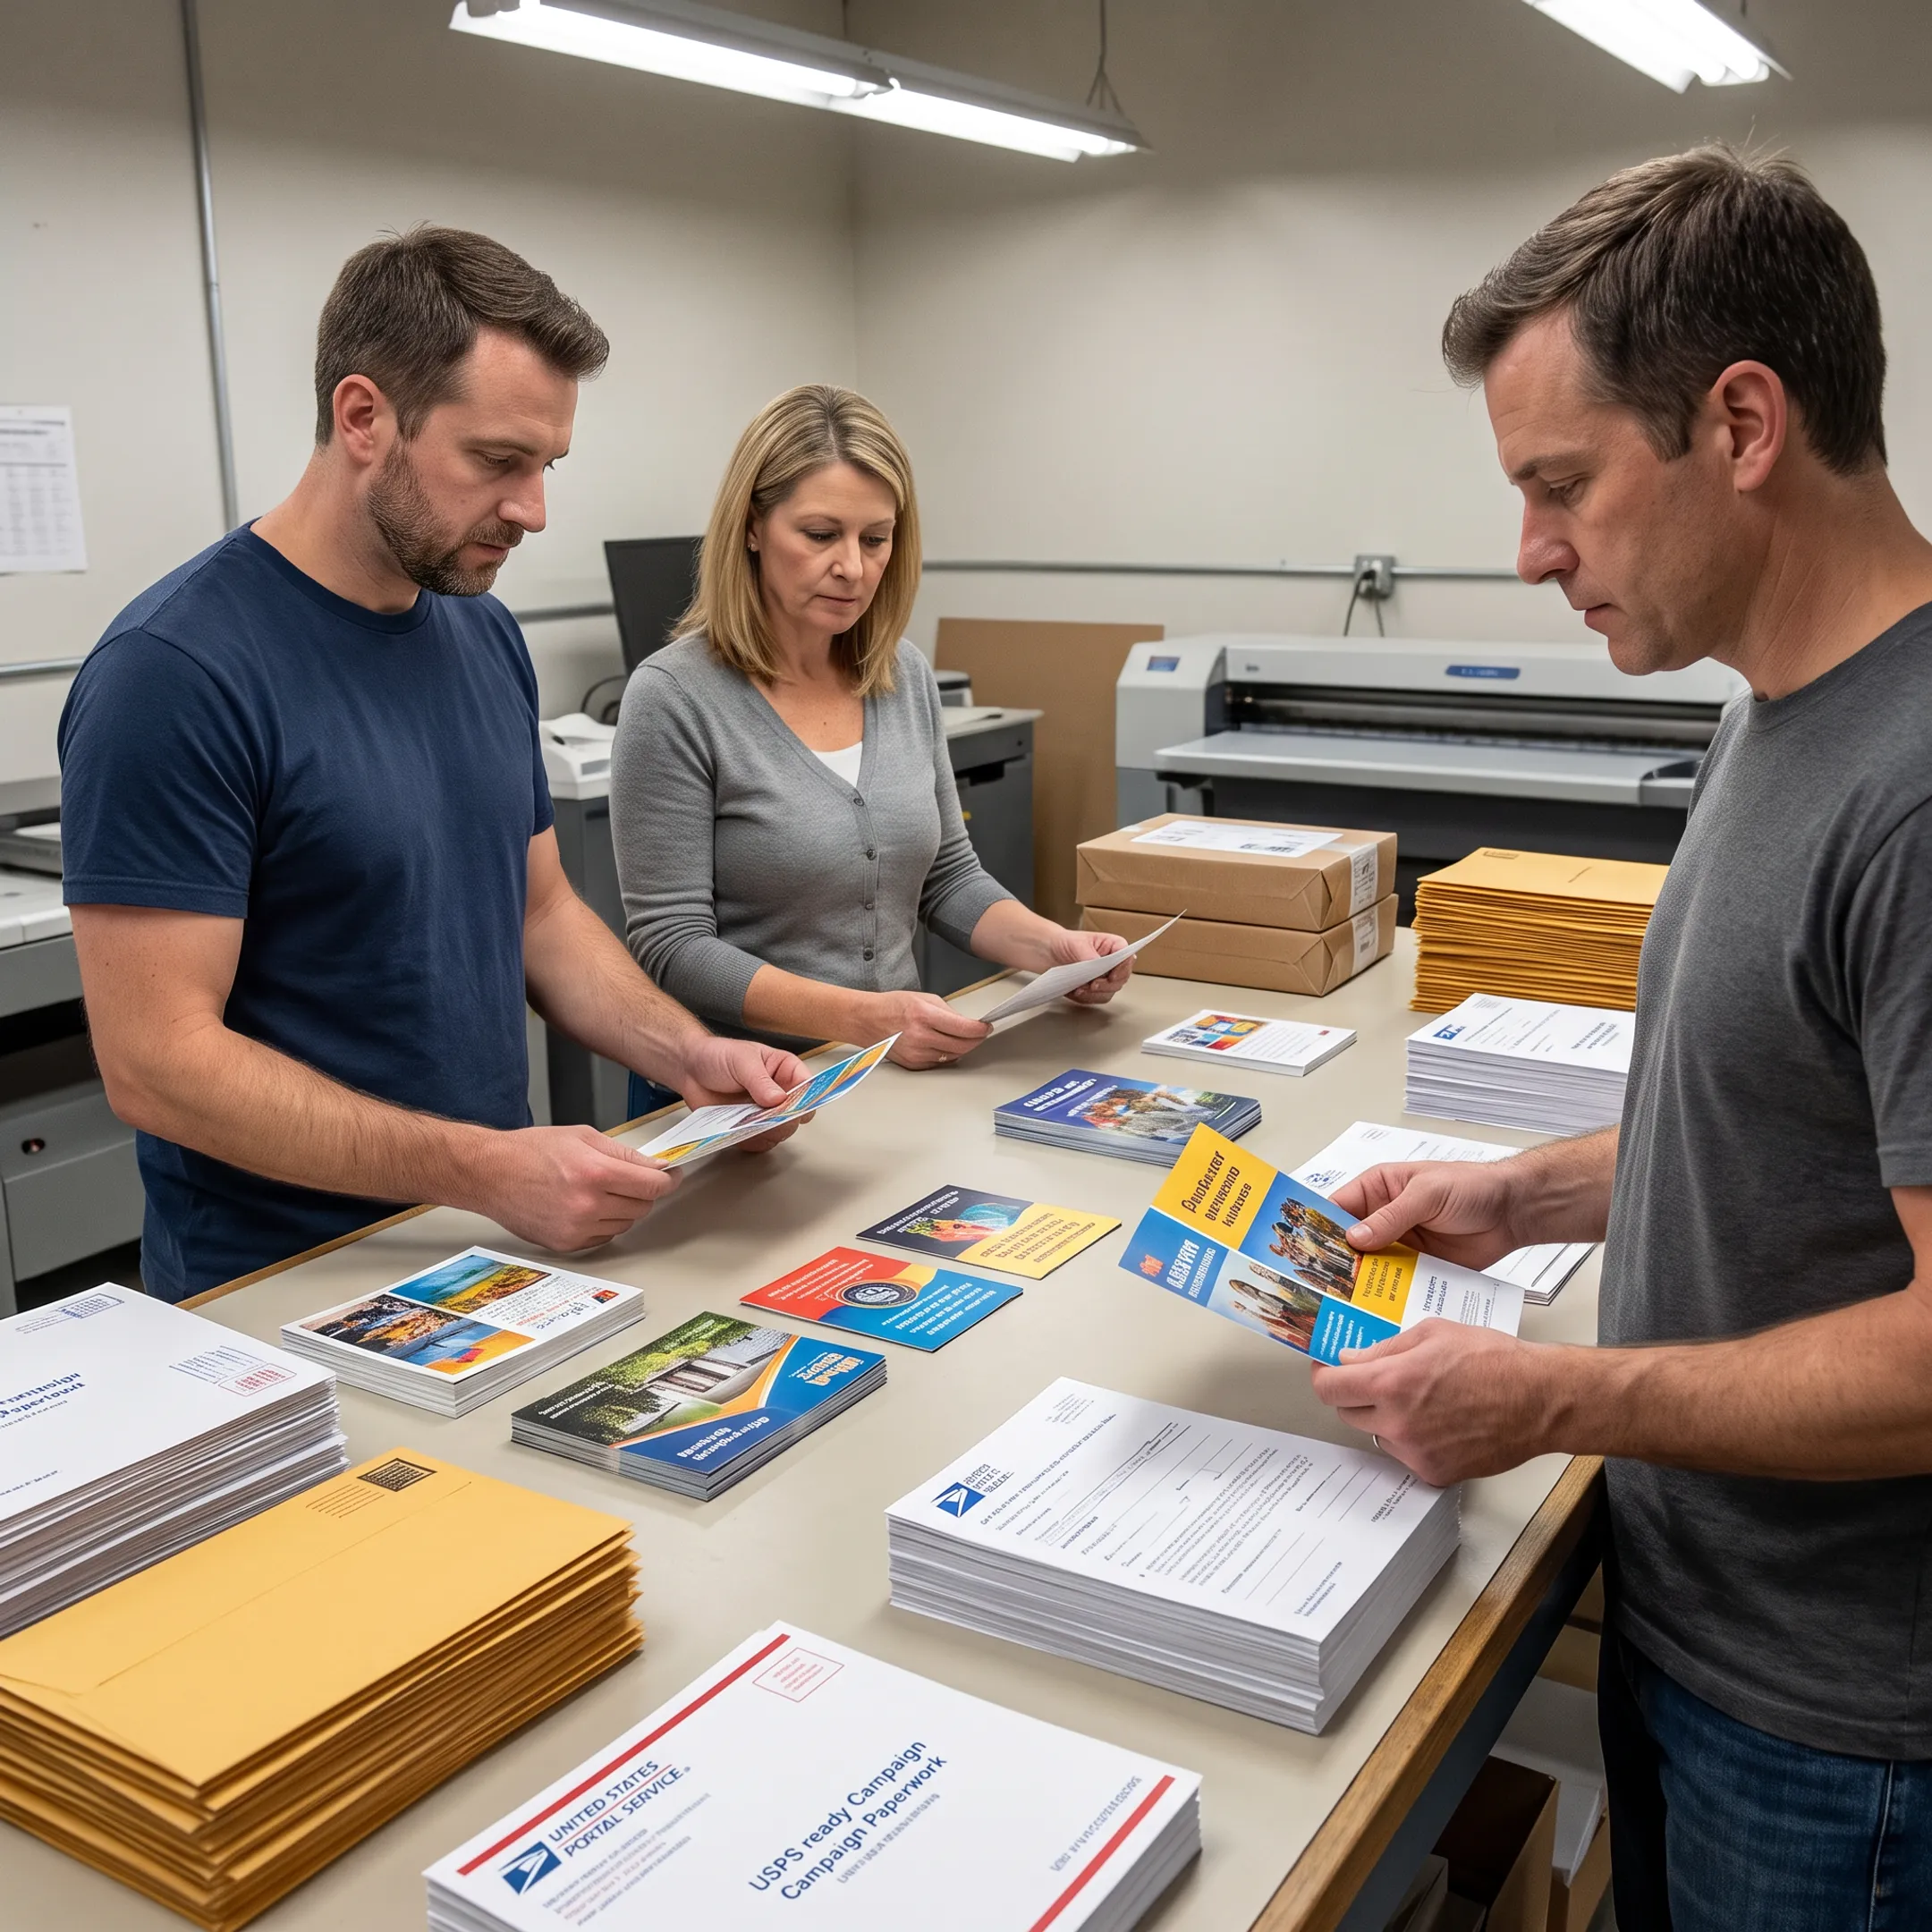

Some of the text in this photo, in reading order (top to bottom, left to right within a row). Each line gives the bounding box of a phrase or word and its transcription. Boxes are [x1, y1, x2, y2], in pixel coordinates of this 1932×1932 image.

[548, 1760, 659, 1843] UNITED STATES
[564, 1814, 623, 1858] PORTAL
[748, 1847, 804, 1892] USPS
[801, 1807, 852, 1849] ready
[846, 1741, 927, 1806] Campaign
[781, 1826, 868, 1900] Campaign
[862, 1755, 947, 1827] Paperwork
